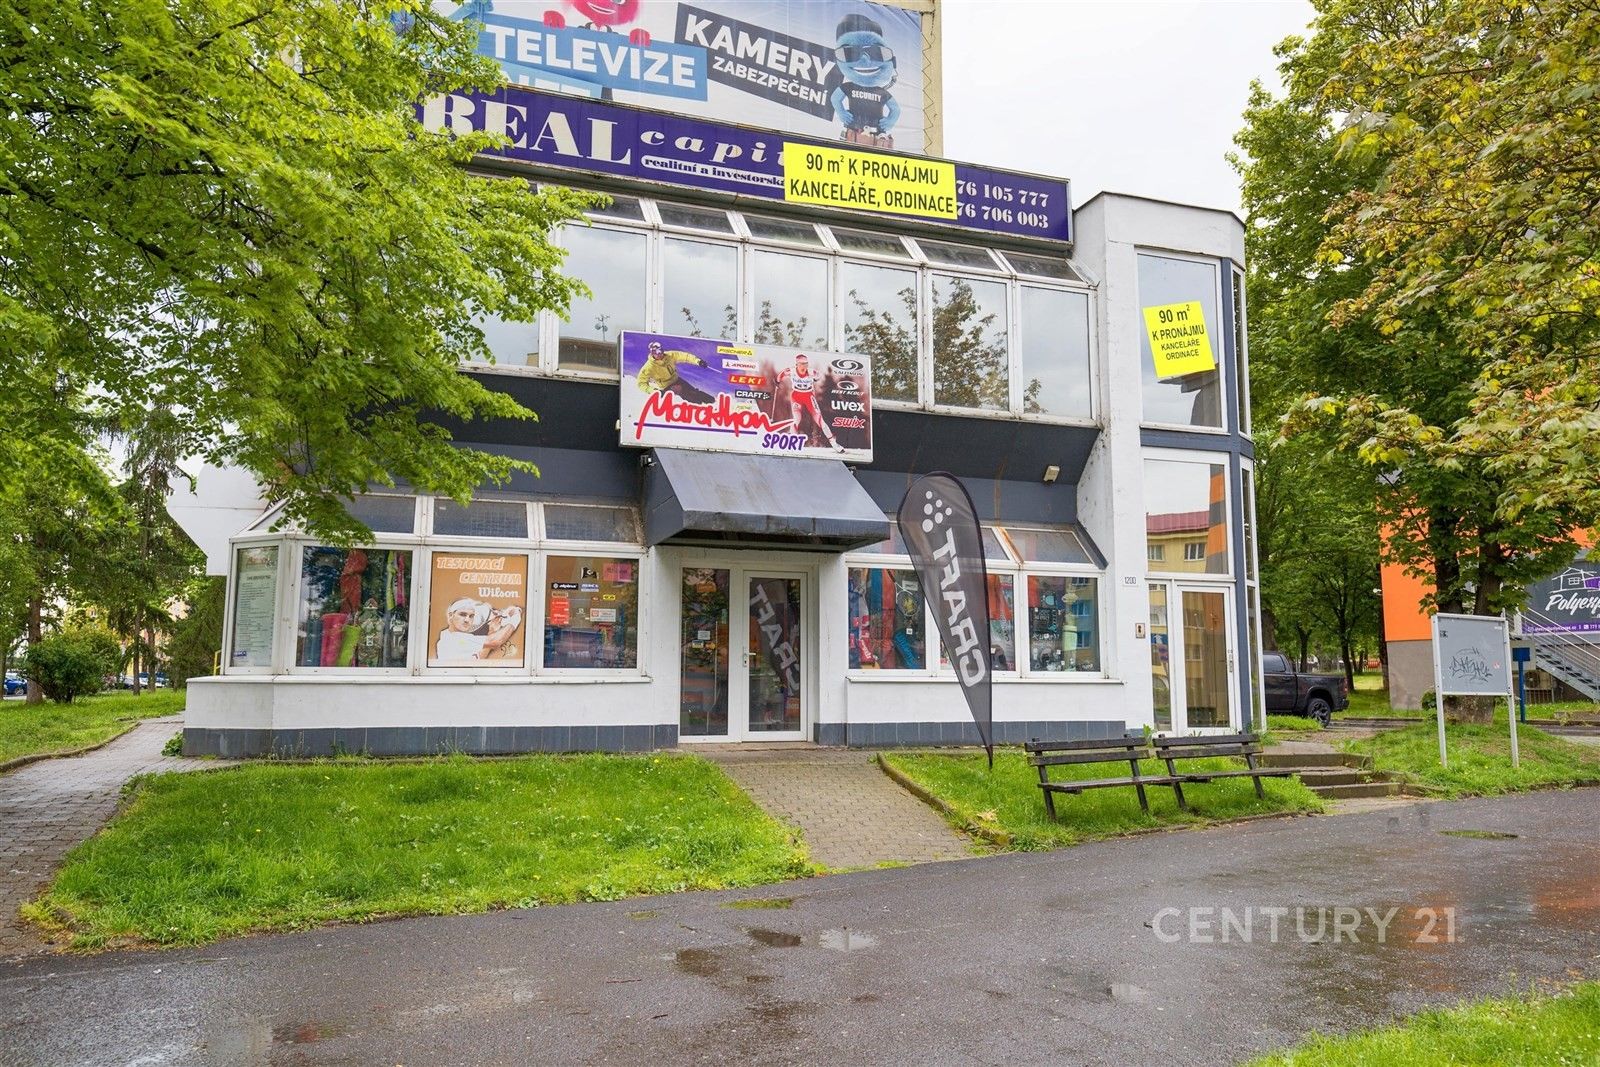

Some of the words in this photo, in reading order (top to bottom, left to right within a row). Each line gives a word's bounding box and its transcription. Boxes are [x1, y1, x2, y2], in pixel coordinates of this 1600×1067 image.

[485, 23, 696, 88] TELEVIZE
[685, 13, 836, 86] KAMERY
[712, 56, 828, 106] ZABEZPEČENÍ
[851, 89, 882, 102] SECURITY
[423, 91, 631, 165] REAL
[644, 158, 697, 174] realitní
[700, 166, 708, 175] a
[806, 153, 823, 171] 90
[827, 155, 845, 173] m²
[848, 158, 858, 176] K
[862, 161, 939, 185] PRONÁJMU
[790, 178, 880, 208] KANCELÁŘE,
[884, 190, 954, 213] ORDINACE
[983, 184, 1013, 202] 105
[1018, 190, 1049, 208] 777
[981, 205, 1013, 223] 706
[1017, 211, 1049, 228] 003
[1158, 309, 1173, 324] 90
[1176, 304, 1190, 321] m²
[1152, 331, 1159, 341] K
[1160, 324, 1205, 340] PRONÁJMU
[1165, 349, 1199, 360] ORDINACE
[730, 375, 762, 385] LEKI
[735, 390, 763, 399] CRAFT
[831, 400, 865, 412] uvex
[636, 394, 790, 439] Marathon
[762, 433, 806, 451] SPORT
[436, 556, 505, 570] TESTOVACÍ
[460, 572, 521, 584] CENTRUM
[1124, 576, 1137, 585] 1200
[478, 587, 519, 598] Wilson
